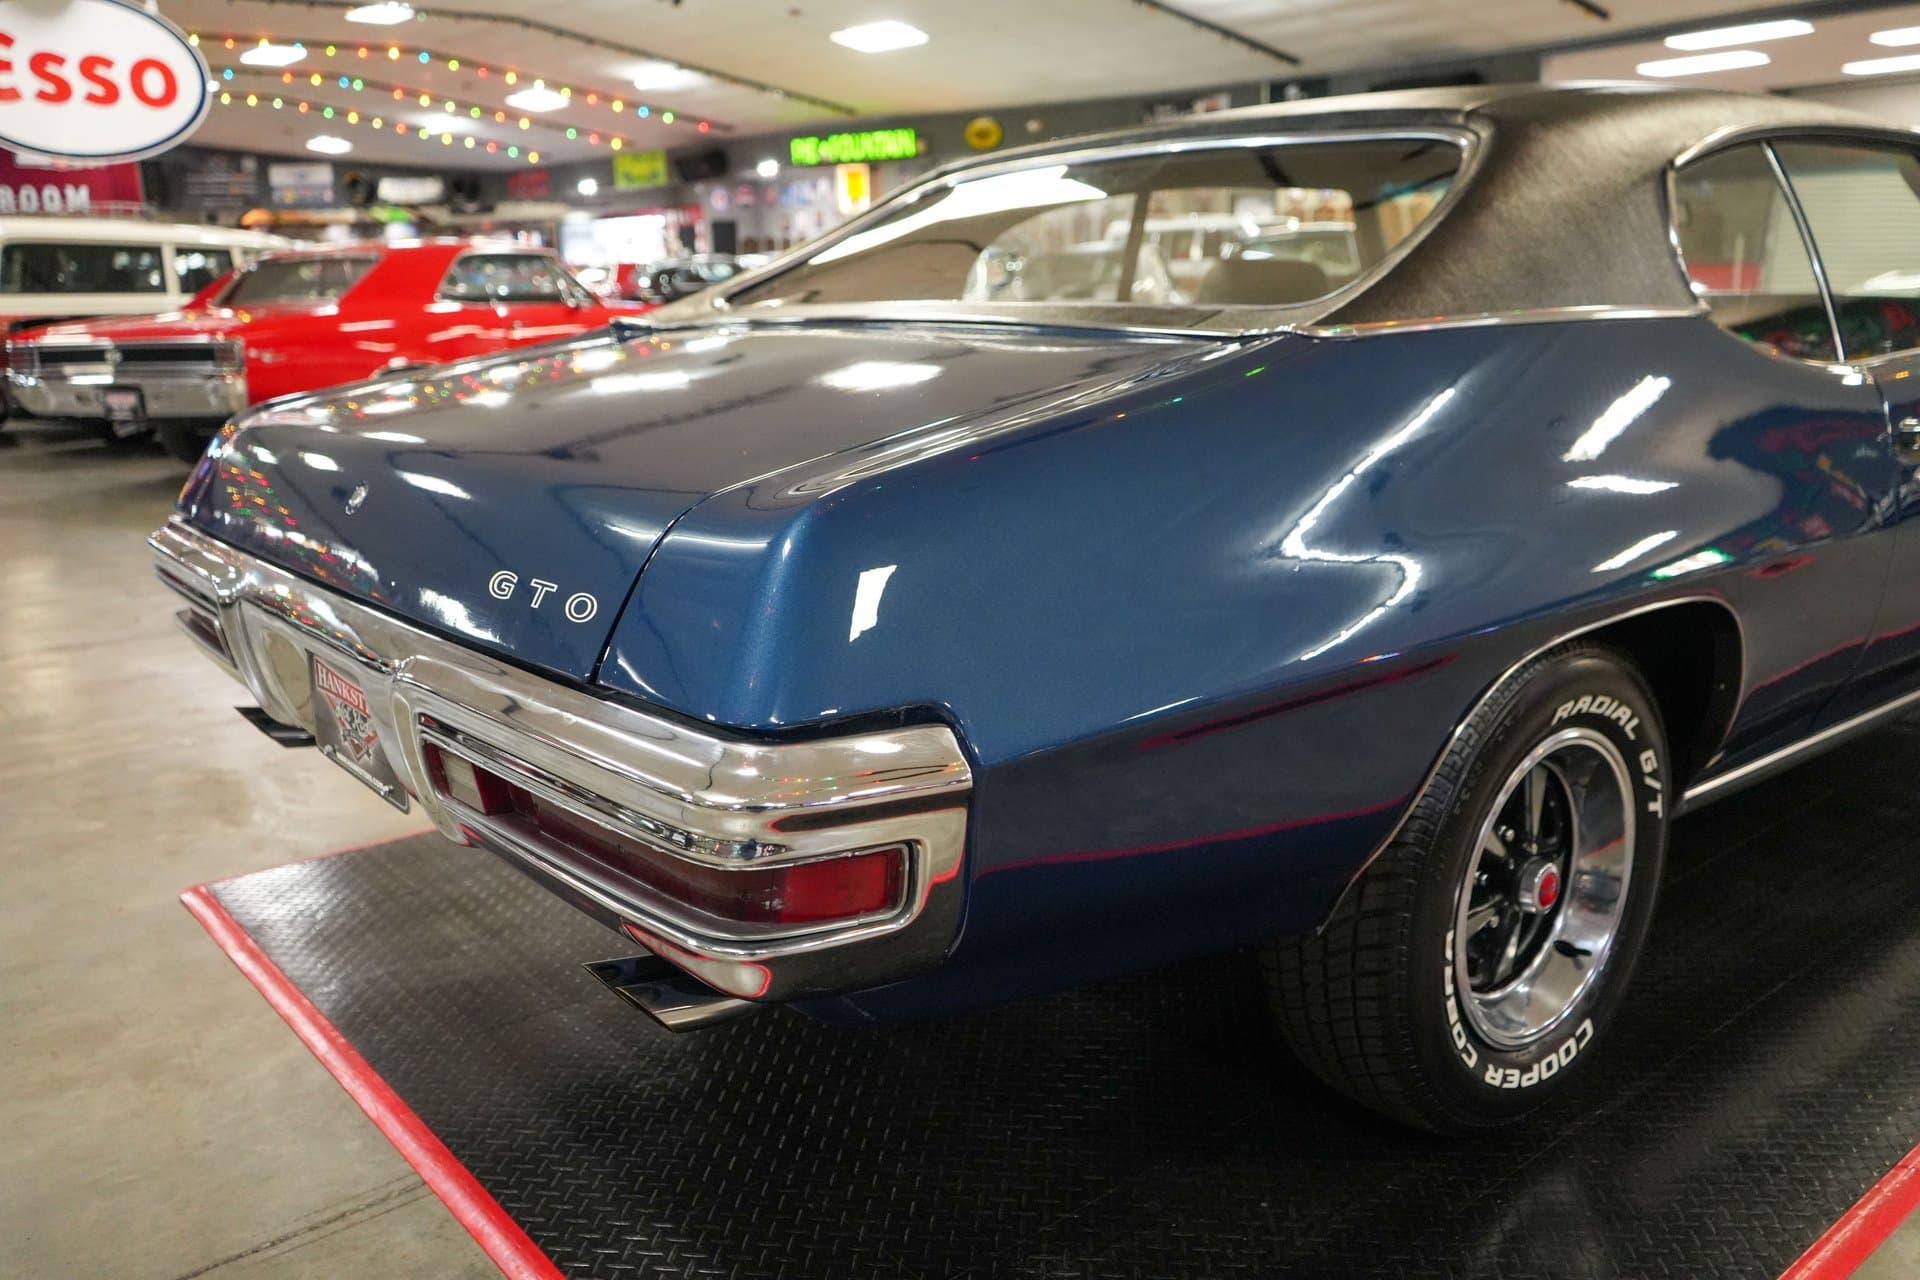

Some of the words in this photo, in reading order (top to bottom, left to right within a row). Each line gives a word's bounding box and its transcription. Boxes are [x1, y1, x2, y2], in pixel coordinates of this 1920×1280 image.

[488, 570, 599, 623] GTO
[1551, 695, 1640, 741] RADIAL
[1639, 749, 1662, 819] G/T
[1484, 1018, 1594, 1089] COOPER
